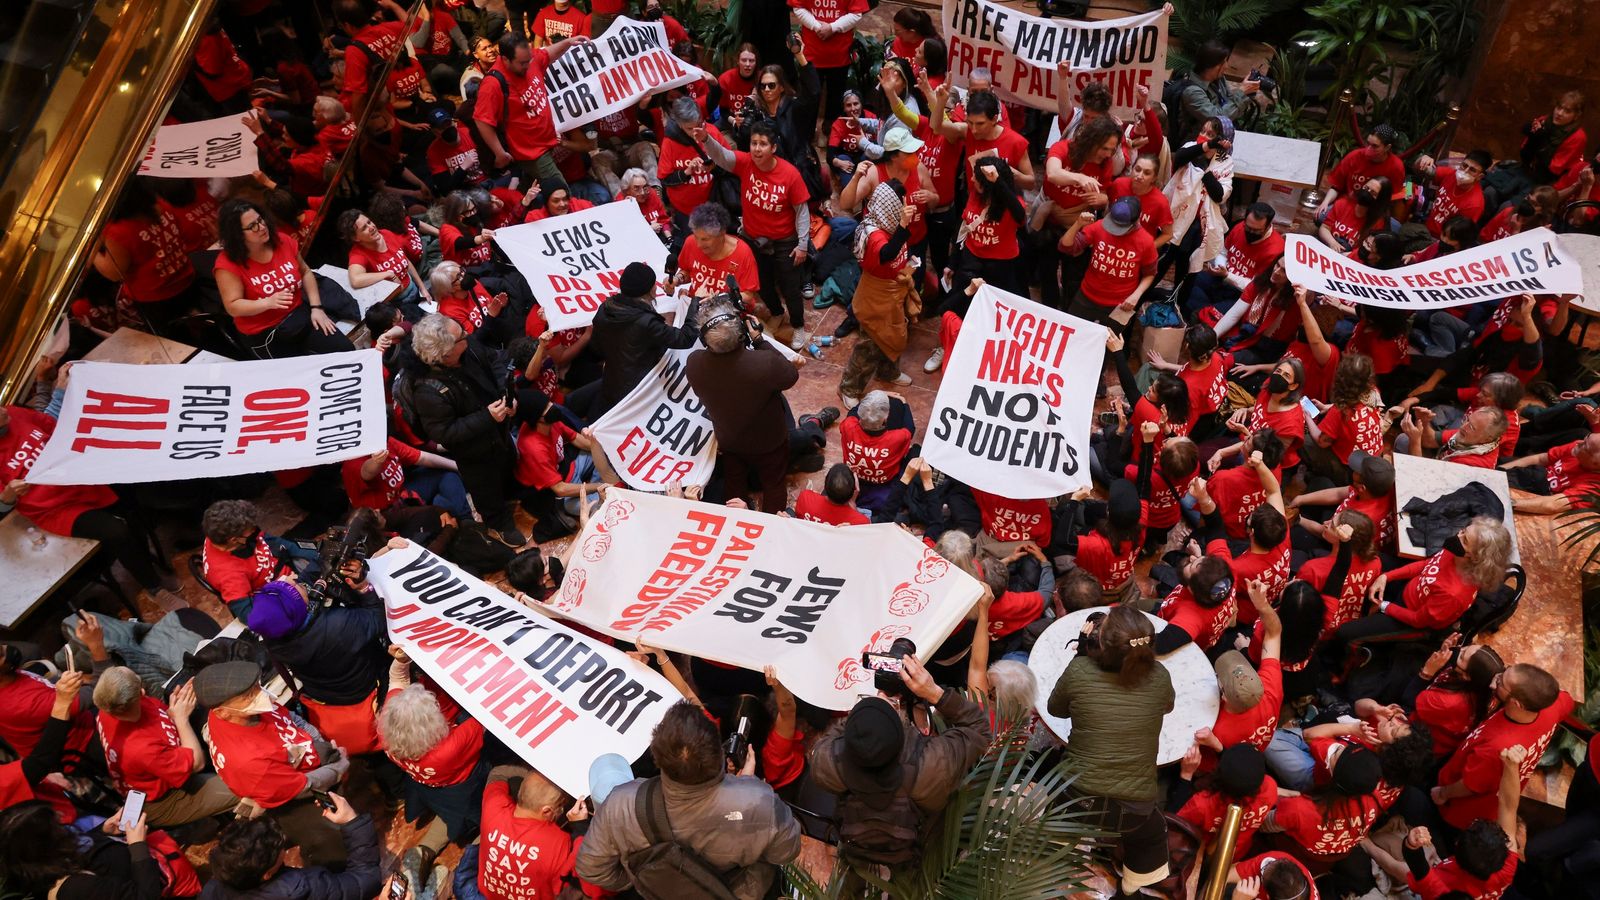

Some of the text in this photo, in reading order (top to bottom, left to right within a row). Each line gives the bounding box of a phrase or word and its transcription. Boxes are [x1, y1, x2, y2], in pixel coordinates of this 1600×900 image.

[545, 19, 574, 32] VETERANS
[812, 8, 841, 18] NAME
[1013, 20, 1159, 69] MAHMOUD
[397, 72, 420, 88] STOP
[544, 41, 606, 96] NEVER
[532, 76, 541, 87] IN
[551, 51, 687, 123] FOR ANYONE
[750, 173, 785, 194] NOT IN
[752, 186, 779, 204] OUR
[746, 190, 783, 212] NAME
[542, 220, 611, 257] JEWS
[1098, 240, 1137, 260] STOP
[376, 255, 396, 272] NOT
[562, 248, 610, 276] SAY
[693, 260, 716, 276] NOT
[1091, 258, 1134, 278] ISRAEL
[1094, 250, 1137, 268] ARMING
[1229, 244, 1256, 269] NOT IN
[1230, 256, 1249, 276] OUR
[1295, 240, 1561, 289] OPPOSING FASCISM IS A
[250, 261, 294, 286] NOT IN
[263, 273, 296, 294] OUR
[696, 272, 726, 290] OUR
[1325, 276, 1546, 304] JEWISH TRADITION
[71, 389, 171, 454] ALL
[227, 388, 311, 455] ONE,
[315, 363, 363, 456] COME FOR
[169, 385, 231, 460] FACE US
[645, 402, 713, 458] BAN
[7, 429, 44, 470] NOT IN
[847, 440, 890, 458] JEWS
[934, 406, 1079, 477] STUDENTS
[616, 425, 695, 485] EVER
[848, 451, 884, 468] SAY
[388, 465, 404, 487] OUR
[994, 507, 1042, 524] JEWS
[639, 520, 765, 632] PALESTINIAN
[714, 568, 792, 624] FOR
[1344, 584, 1368, 596] AY
[761, 566, 847, 645] JEWS
[389, 550, 664, 735] YOU CAN'T DEPORT
[407, 616, 579, 749] MOVEMENT
[1317, 808, 1376, 831] JEWS
[488, 829, 540, 861] JEWS
[488, 846, 529, 874] SAY
[484, 871, 536, 896] ARMING
[485, 860, 531, 886] STOP
